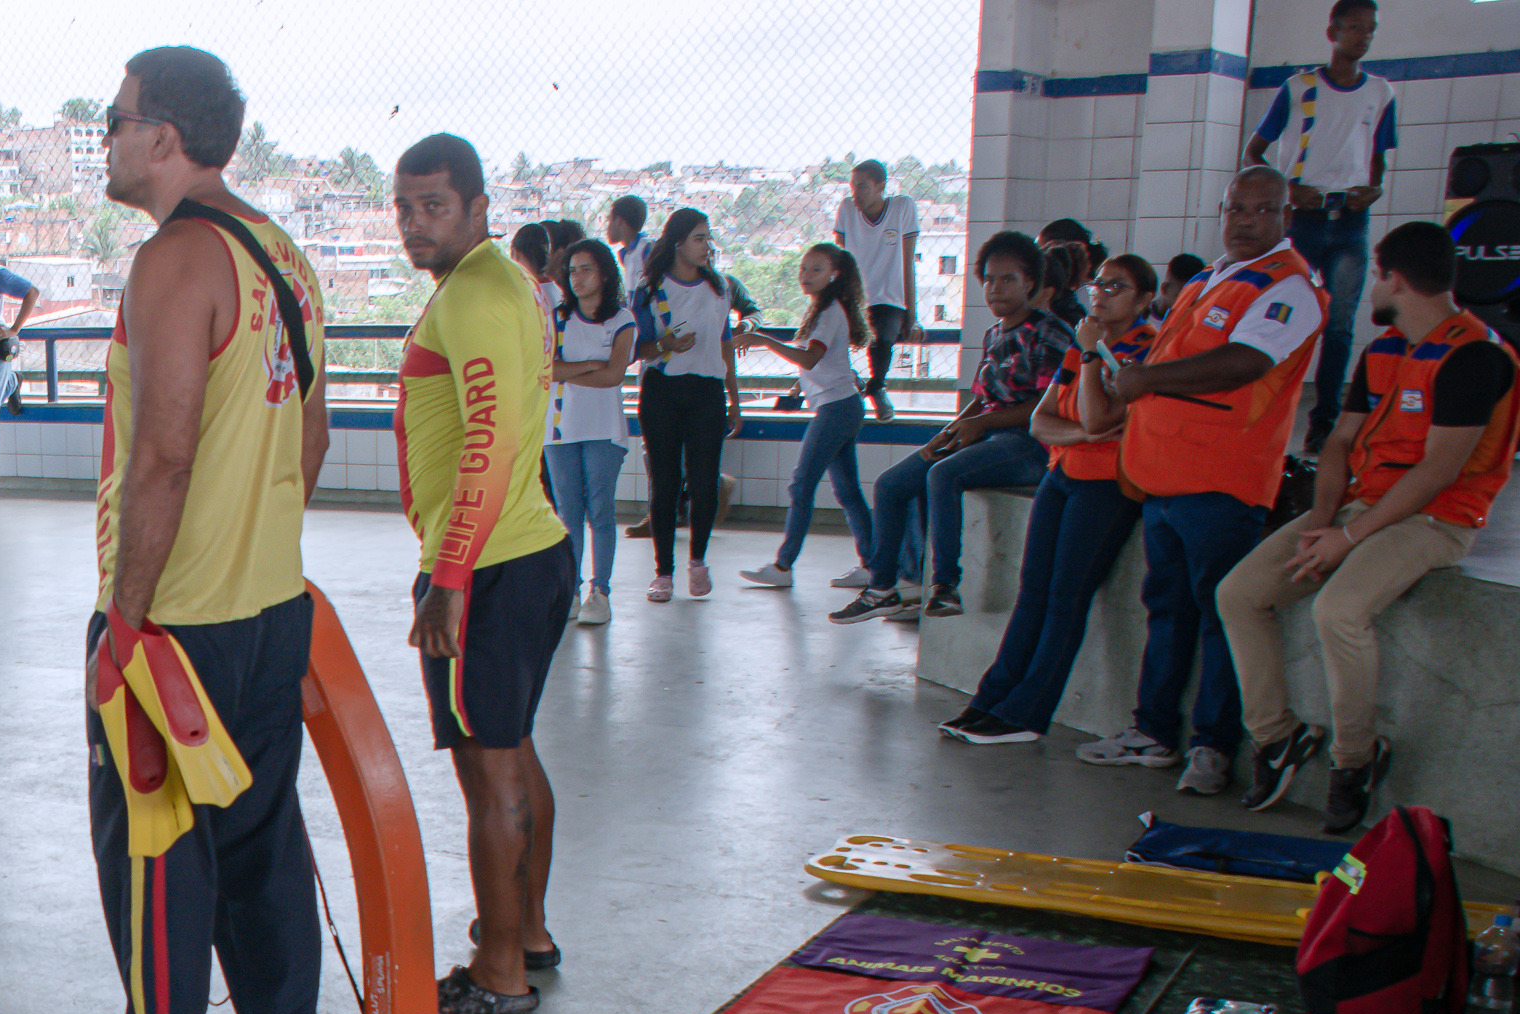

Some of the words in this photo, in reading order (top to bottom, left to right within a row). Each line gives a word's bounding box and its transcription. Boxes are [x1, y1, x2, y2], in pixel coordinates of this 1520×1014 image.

[1455, 246, 1520, 260] PULSE
[459, 357, 497, 475] GUARD
[436, 488, 486, 565] LIFE
[827, 956, 935, 973] ANIMAIS
[940, 967, 1082, 998] MARINHOS
